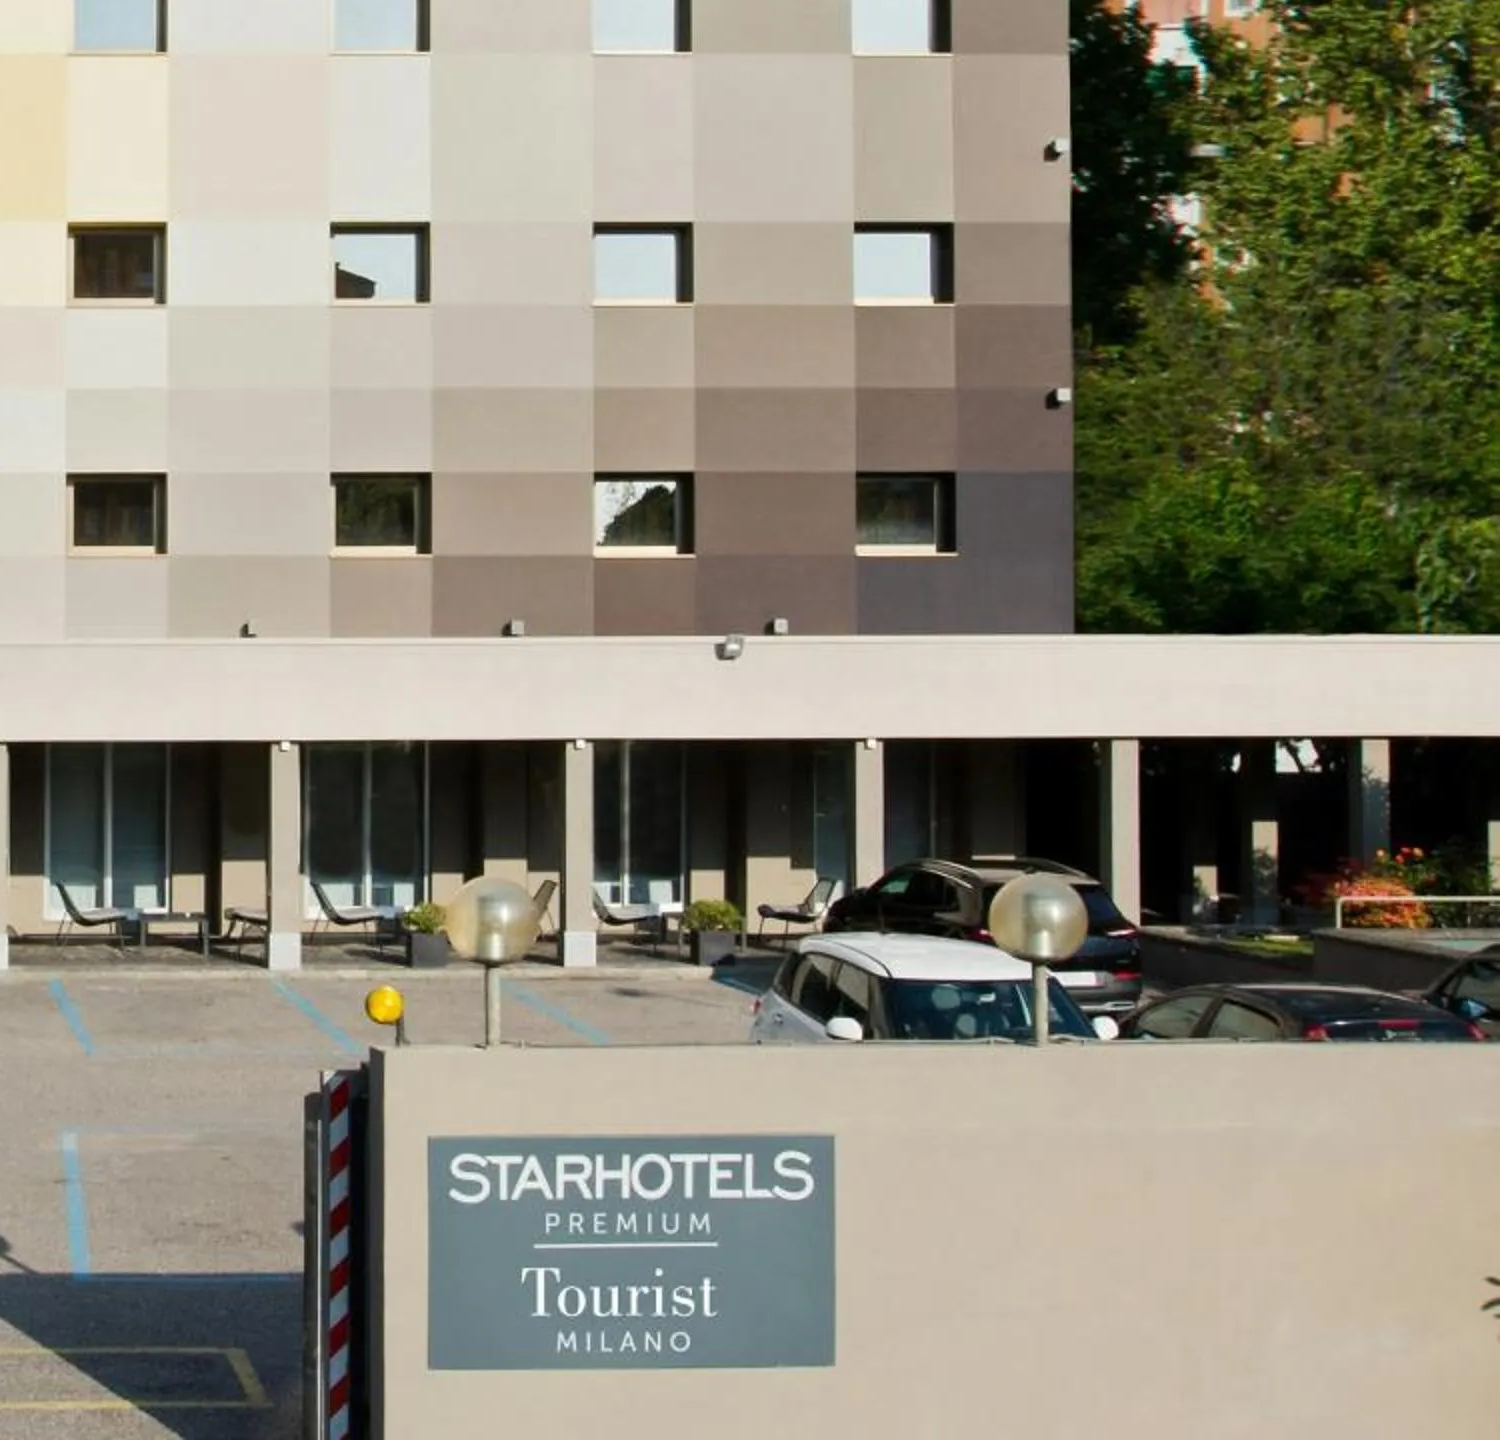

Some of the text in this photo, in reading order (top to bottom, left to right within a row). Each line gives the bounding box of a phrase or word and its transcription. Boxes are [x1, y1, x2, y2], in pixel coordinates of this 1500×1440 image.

[449, 1150, 815, 1204] STARHOTELS
[544, 1212, 711, 1235] PREMIUM
[521, 1267, 718, 1318] Tourist
[556, 1331, 692, 1354] MILANO
